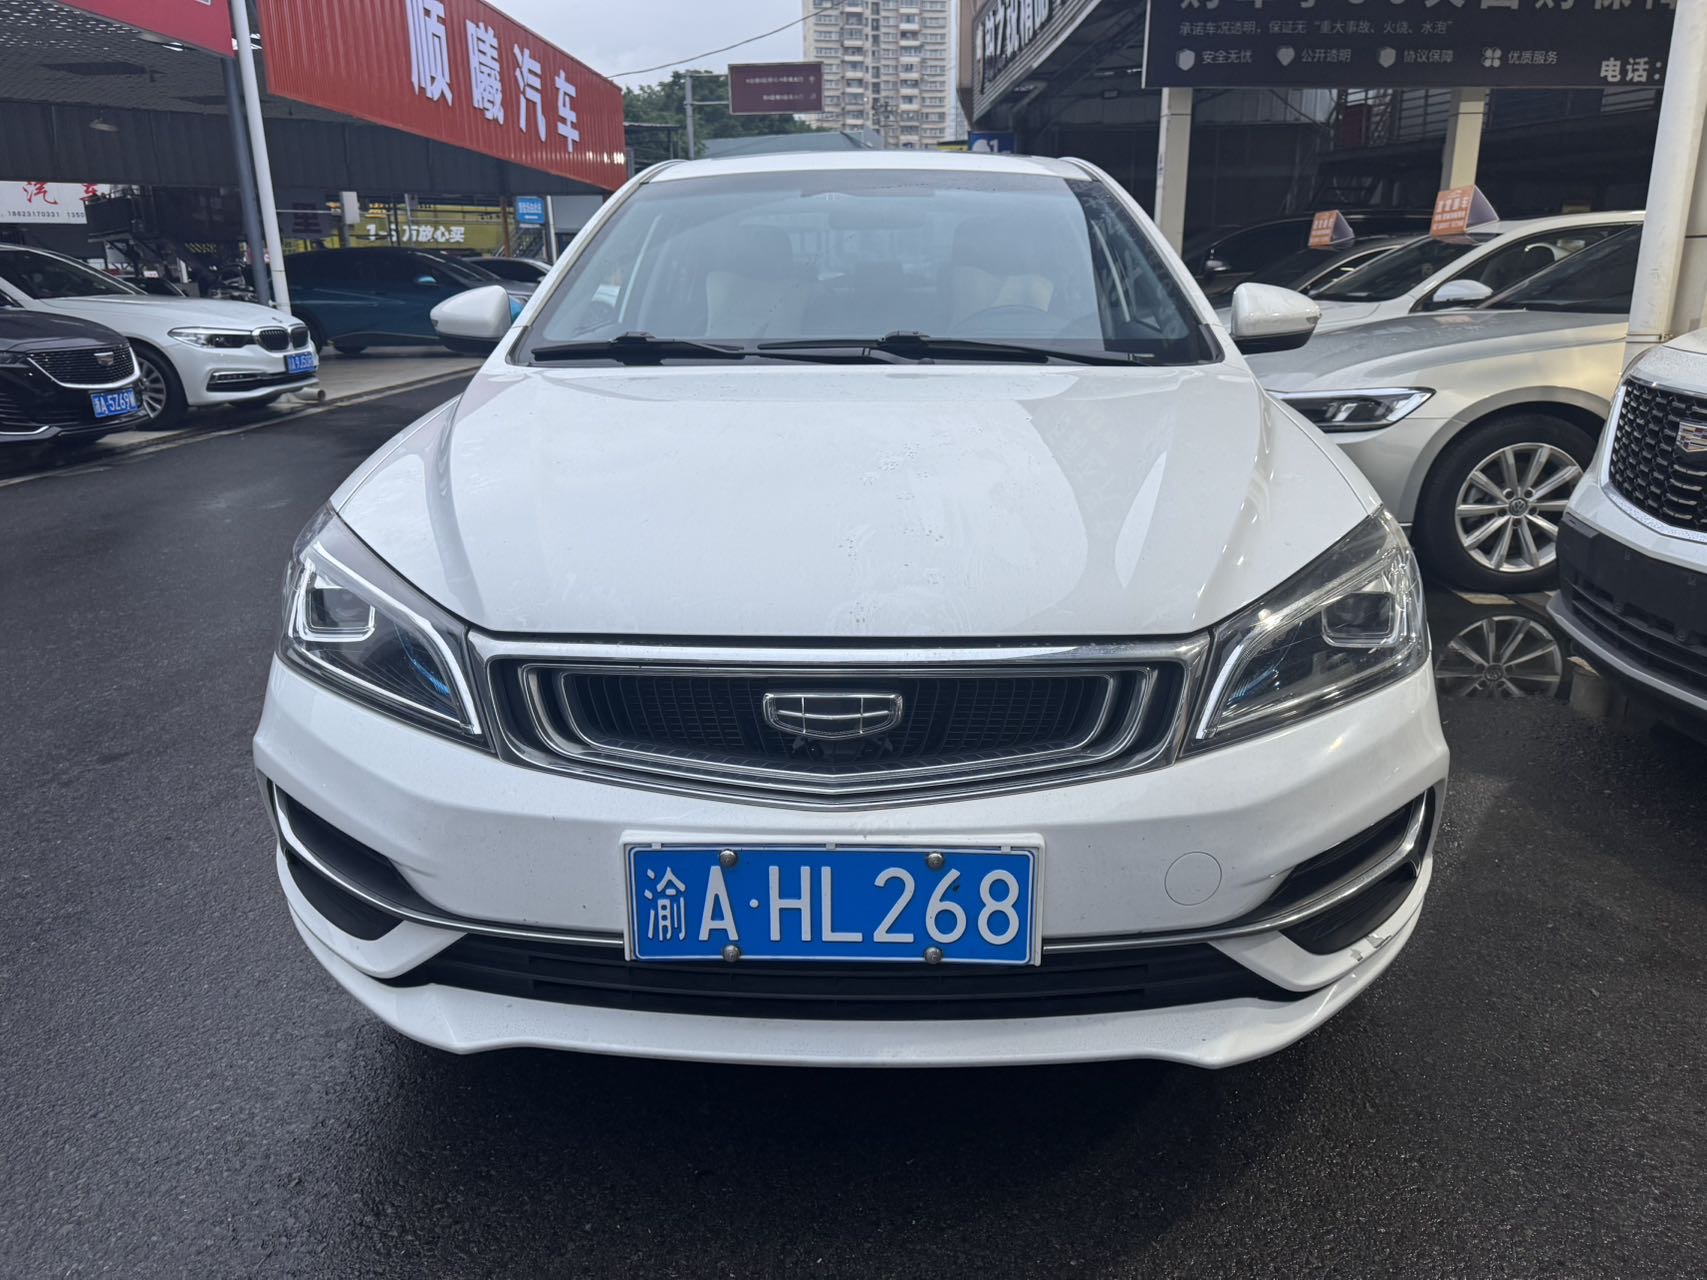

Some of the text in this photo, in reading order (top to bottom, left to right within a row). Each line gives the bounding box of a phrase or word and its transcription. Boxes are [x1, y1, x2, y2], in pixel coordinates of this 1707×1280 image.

[406, 0, 580, 153] 顺曦汽车
[1201, 49, 1559, 65] 安全无忧 公开透明 协议保障 优质服务
[644, 865, 1021, 946] 渝A·HL268
